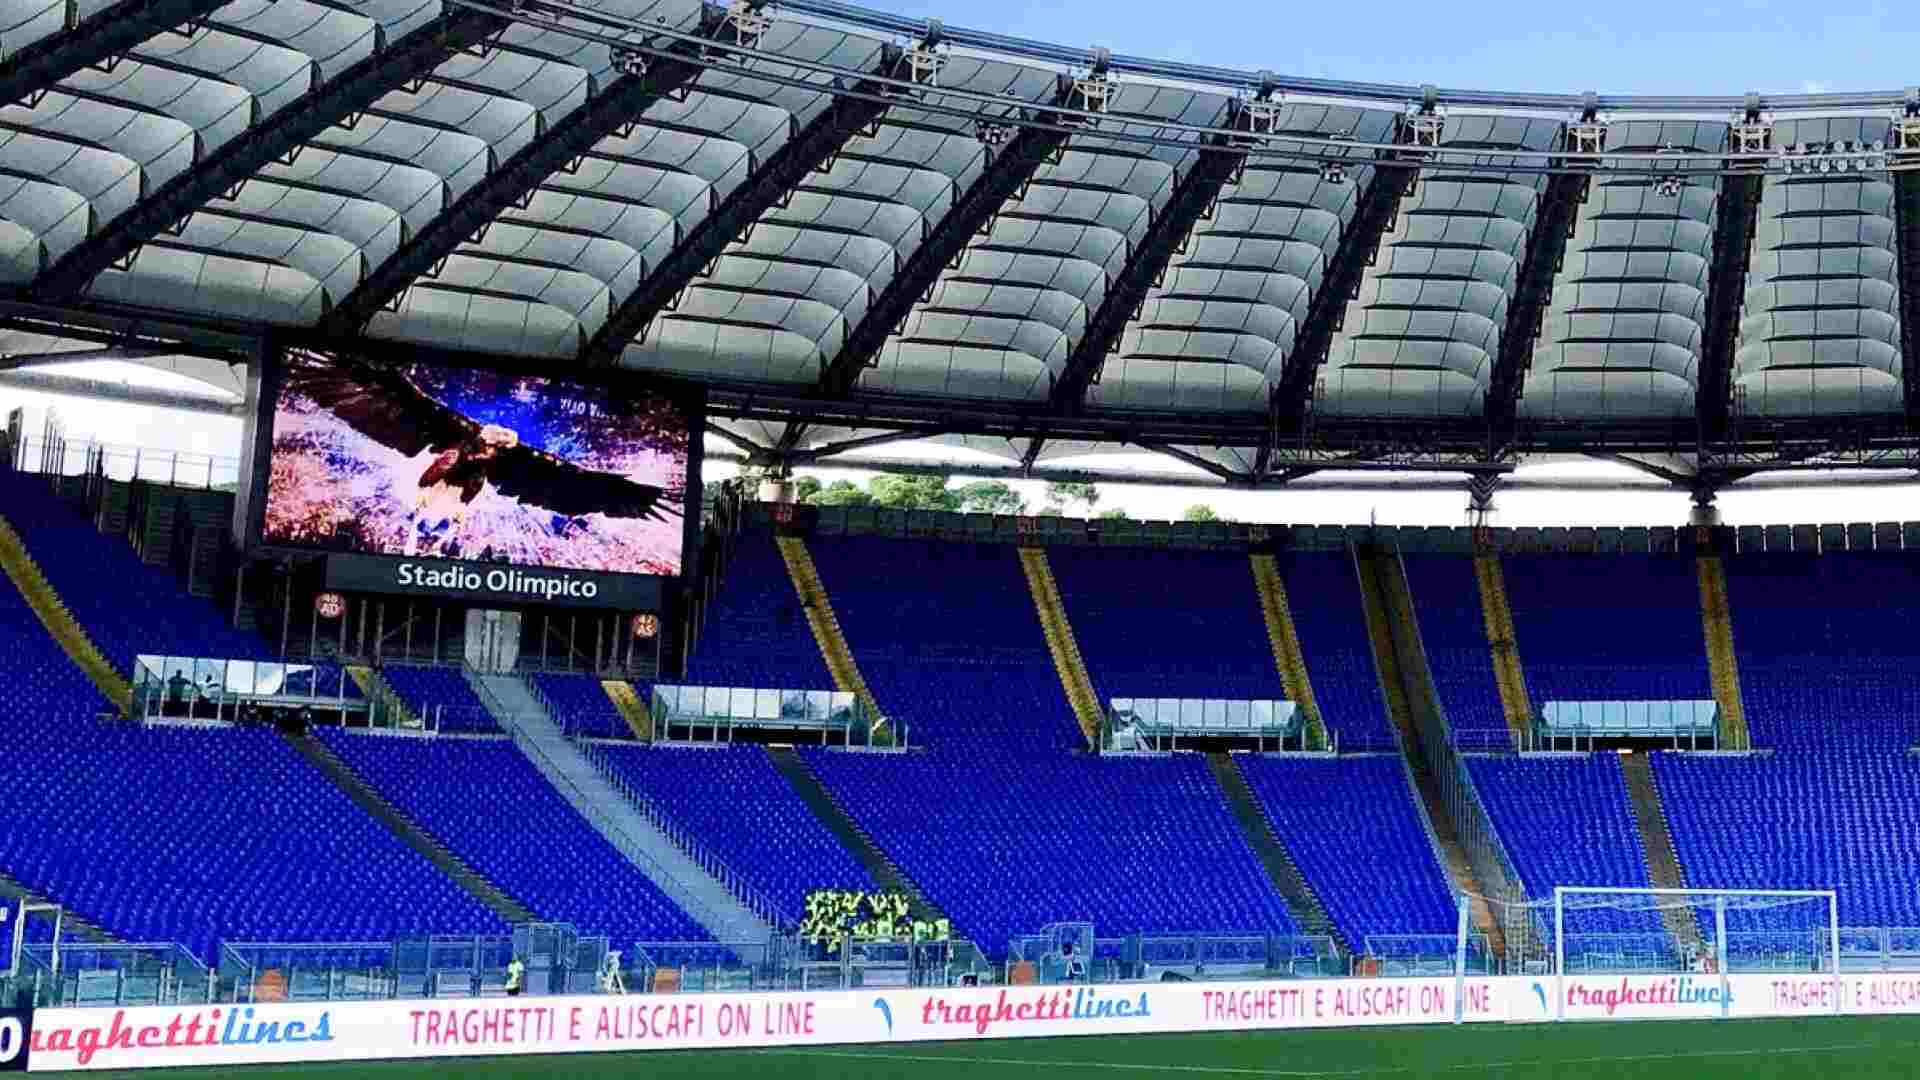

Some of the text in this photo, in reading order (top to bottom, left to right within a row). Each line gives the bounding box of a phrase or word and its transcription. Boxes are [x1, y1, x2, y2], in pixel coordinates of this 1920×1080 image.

[398, 563, 597, 600] Stadio Olimpico
[409, 1002, 814, 1044] TRAGHETTI E ALISCAFI ON LINE
[922, 987, 1151, 1034] traghettilines
[1203, 985, 1490, 1020] TRAGHETTI E ALISCAFI ON INE
[31, 1007, 334, 1065] raghettilines
